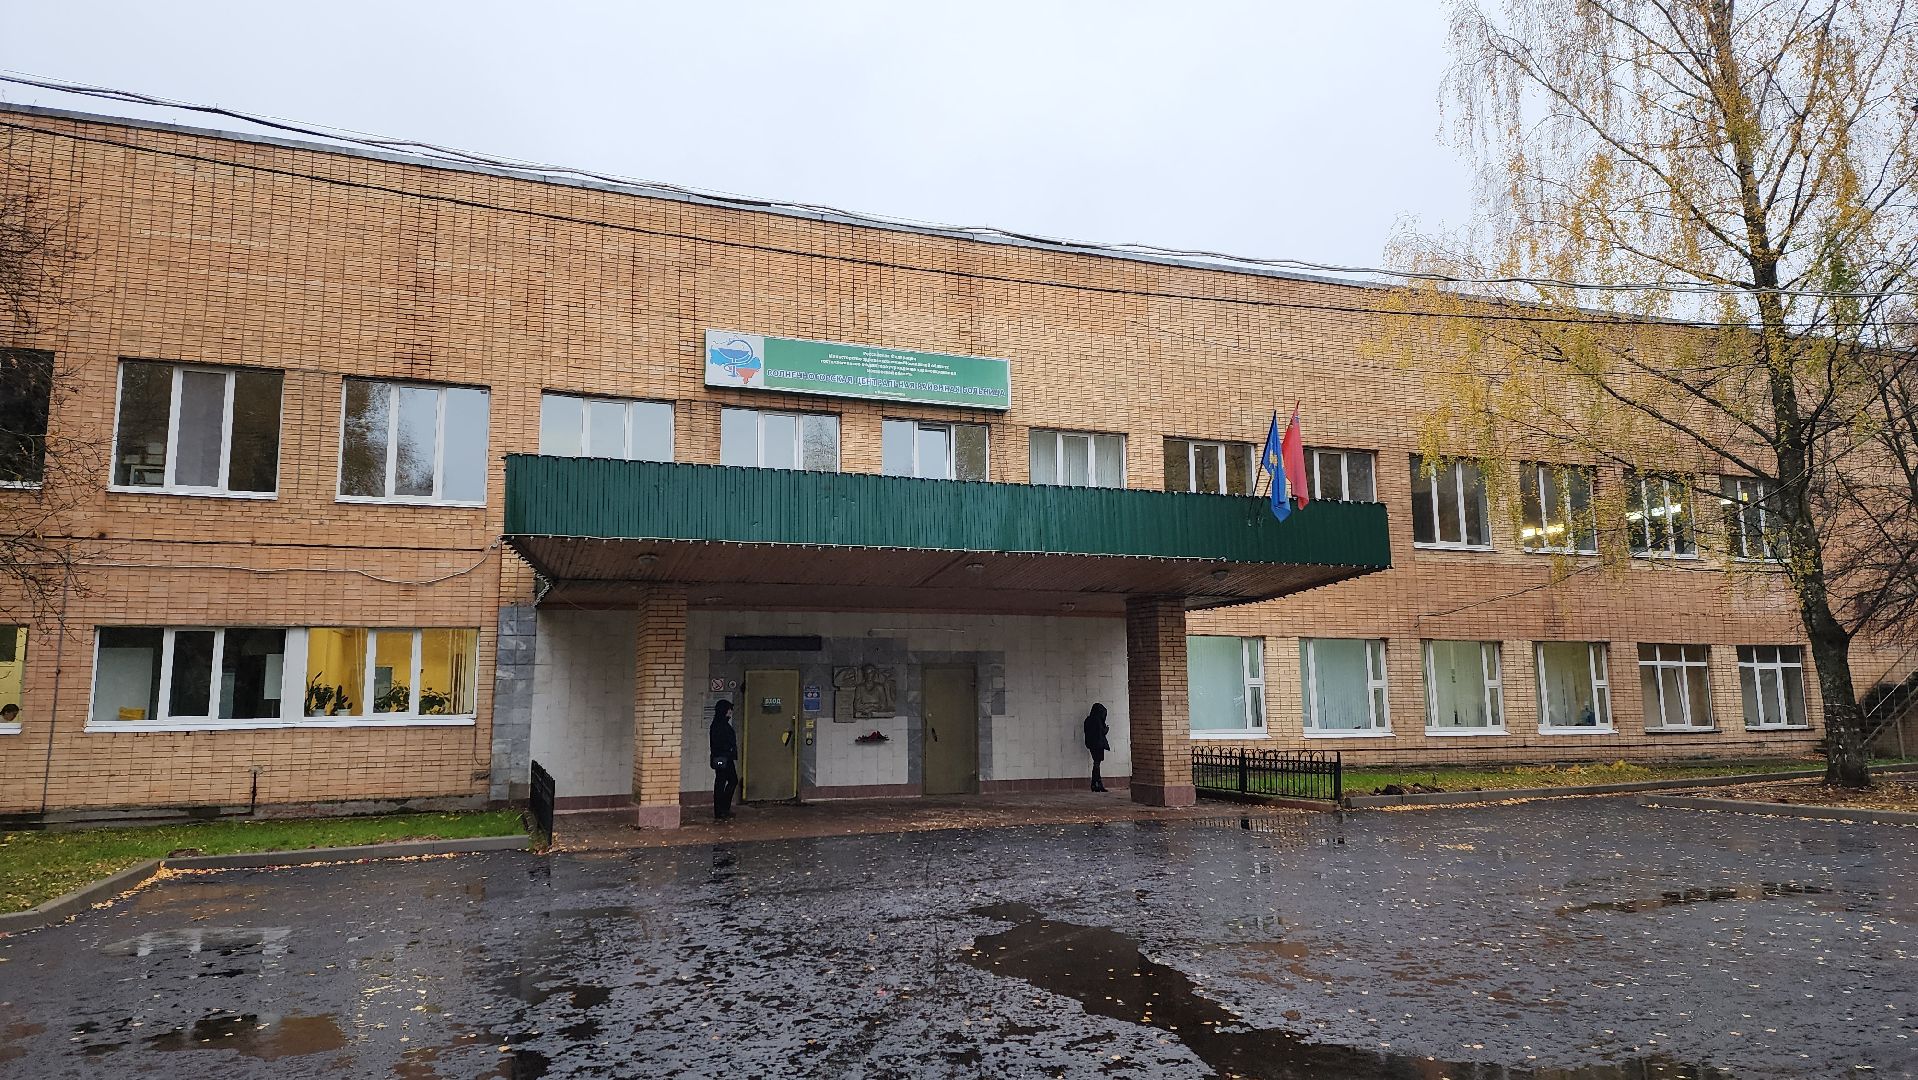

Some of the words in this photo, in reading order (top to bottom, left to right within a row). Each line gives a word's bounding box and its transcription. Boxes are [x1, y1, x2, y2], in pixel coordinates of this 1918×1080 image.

[855, 376, 915, 389] ЦЕНТРАЛЬНАЯ
[916, 380, 960, 394] РАЙОННАЯ
[961, 385, 1006, 398] БОЛЬНИЦА
